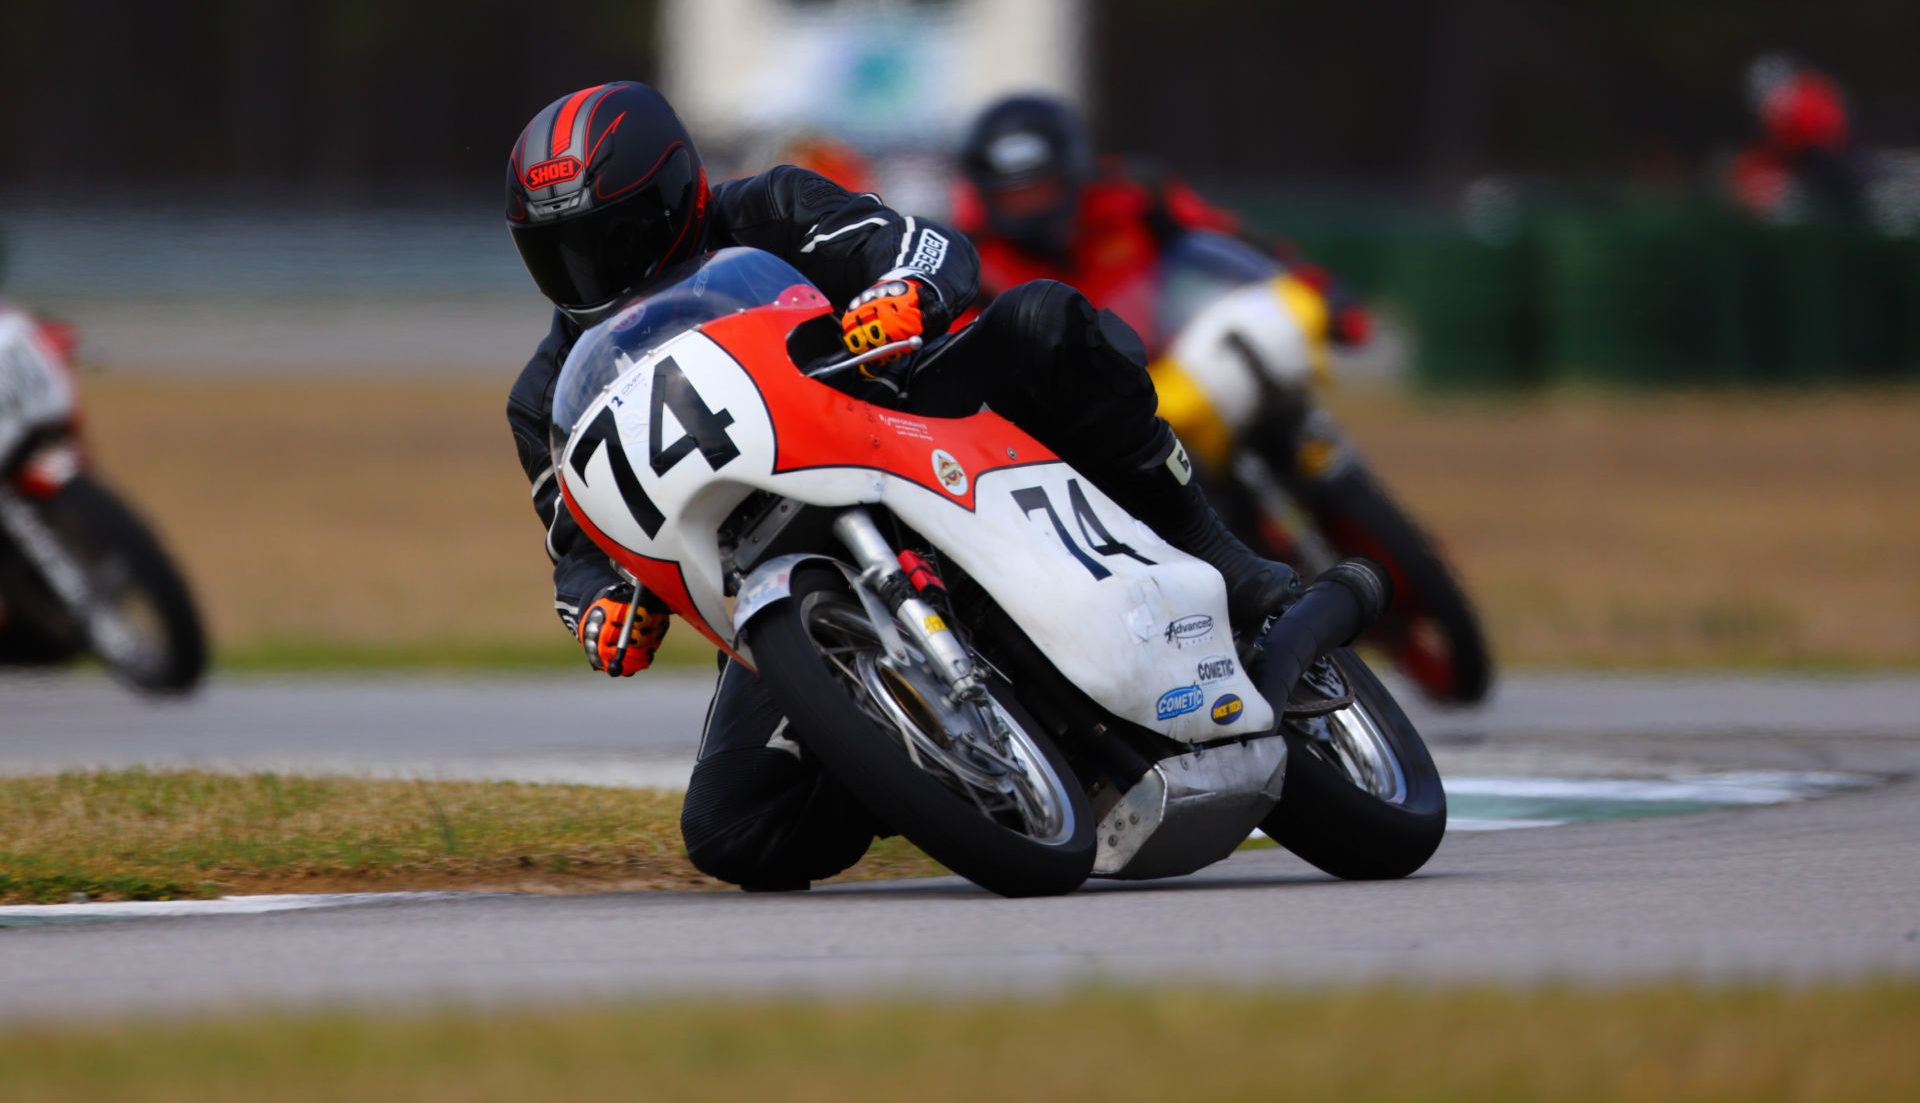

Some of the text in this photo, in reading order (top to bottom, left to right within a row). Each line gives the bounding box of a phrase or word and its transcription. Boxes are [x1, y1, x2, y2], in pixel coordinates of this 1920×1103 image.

[530, 160, 574, 186] SHOEI
[569, 355, 740, 541] 74
[1009, 478, 1159, 581] 74
[1164, 619, 1212, 643] Advanced
[1198, 658, 1234, 680] COMETIC
[1159, 689, 1203, 714] COMETIC
